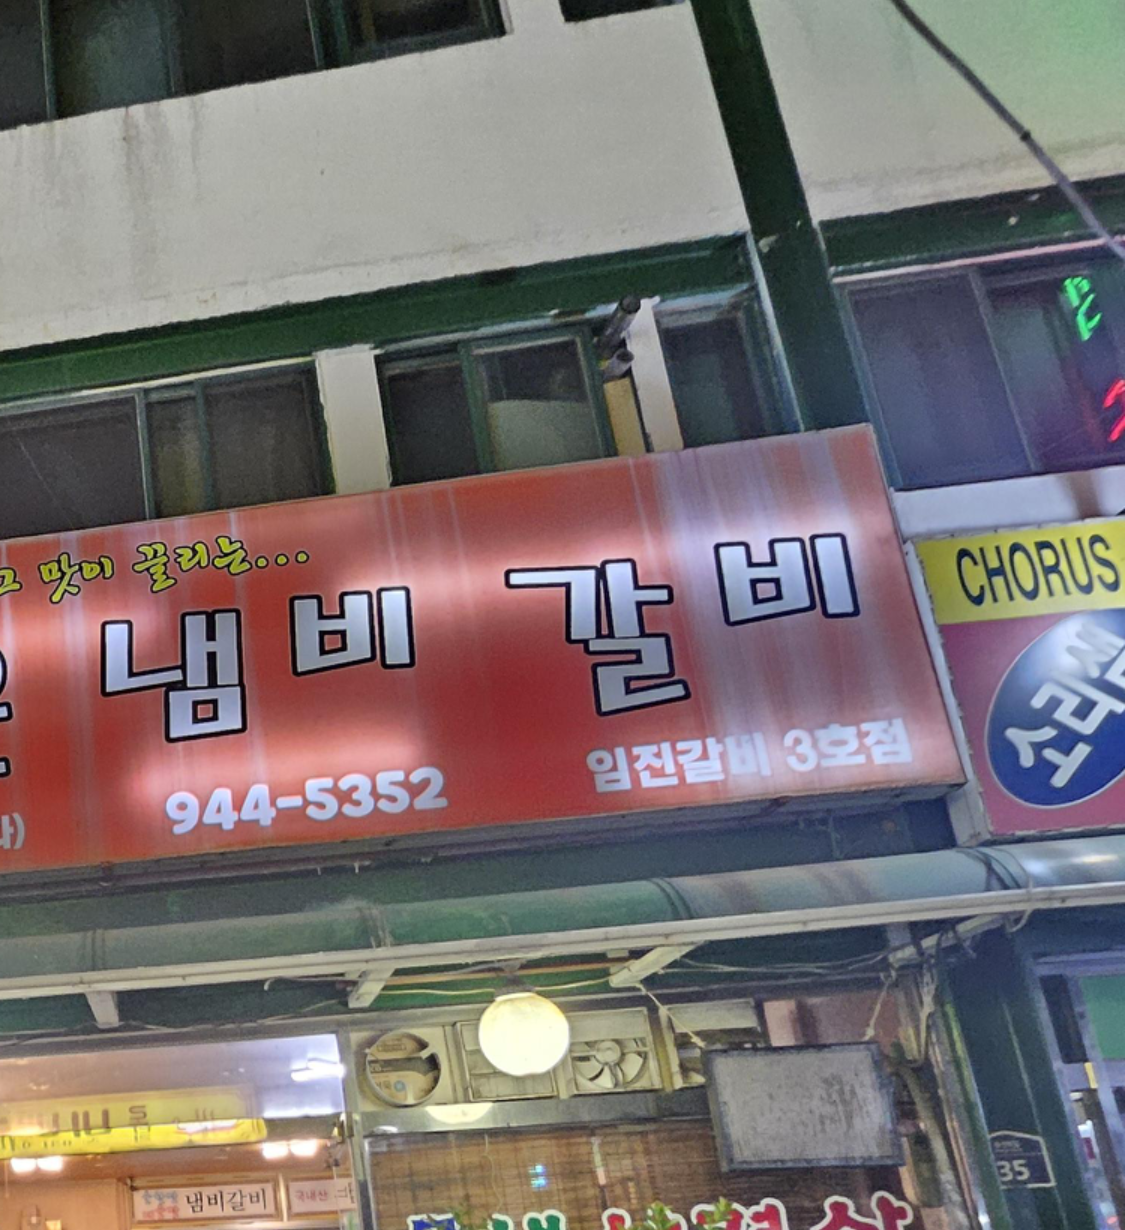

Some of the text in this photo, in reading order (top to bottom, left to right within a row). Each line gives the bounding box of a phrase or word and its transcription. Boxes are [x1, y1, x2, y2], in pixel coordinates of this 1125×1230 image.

[38, 552, 114, 604] 맛이
[956, 534, 1120, 606] CHORUS
[586, 718, 913, 793] 임진갈비 3호점
[165, 766, 448, 835] 944-5352
[996, 1160, 1030, 1181] 35
